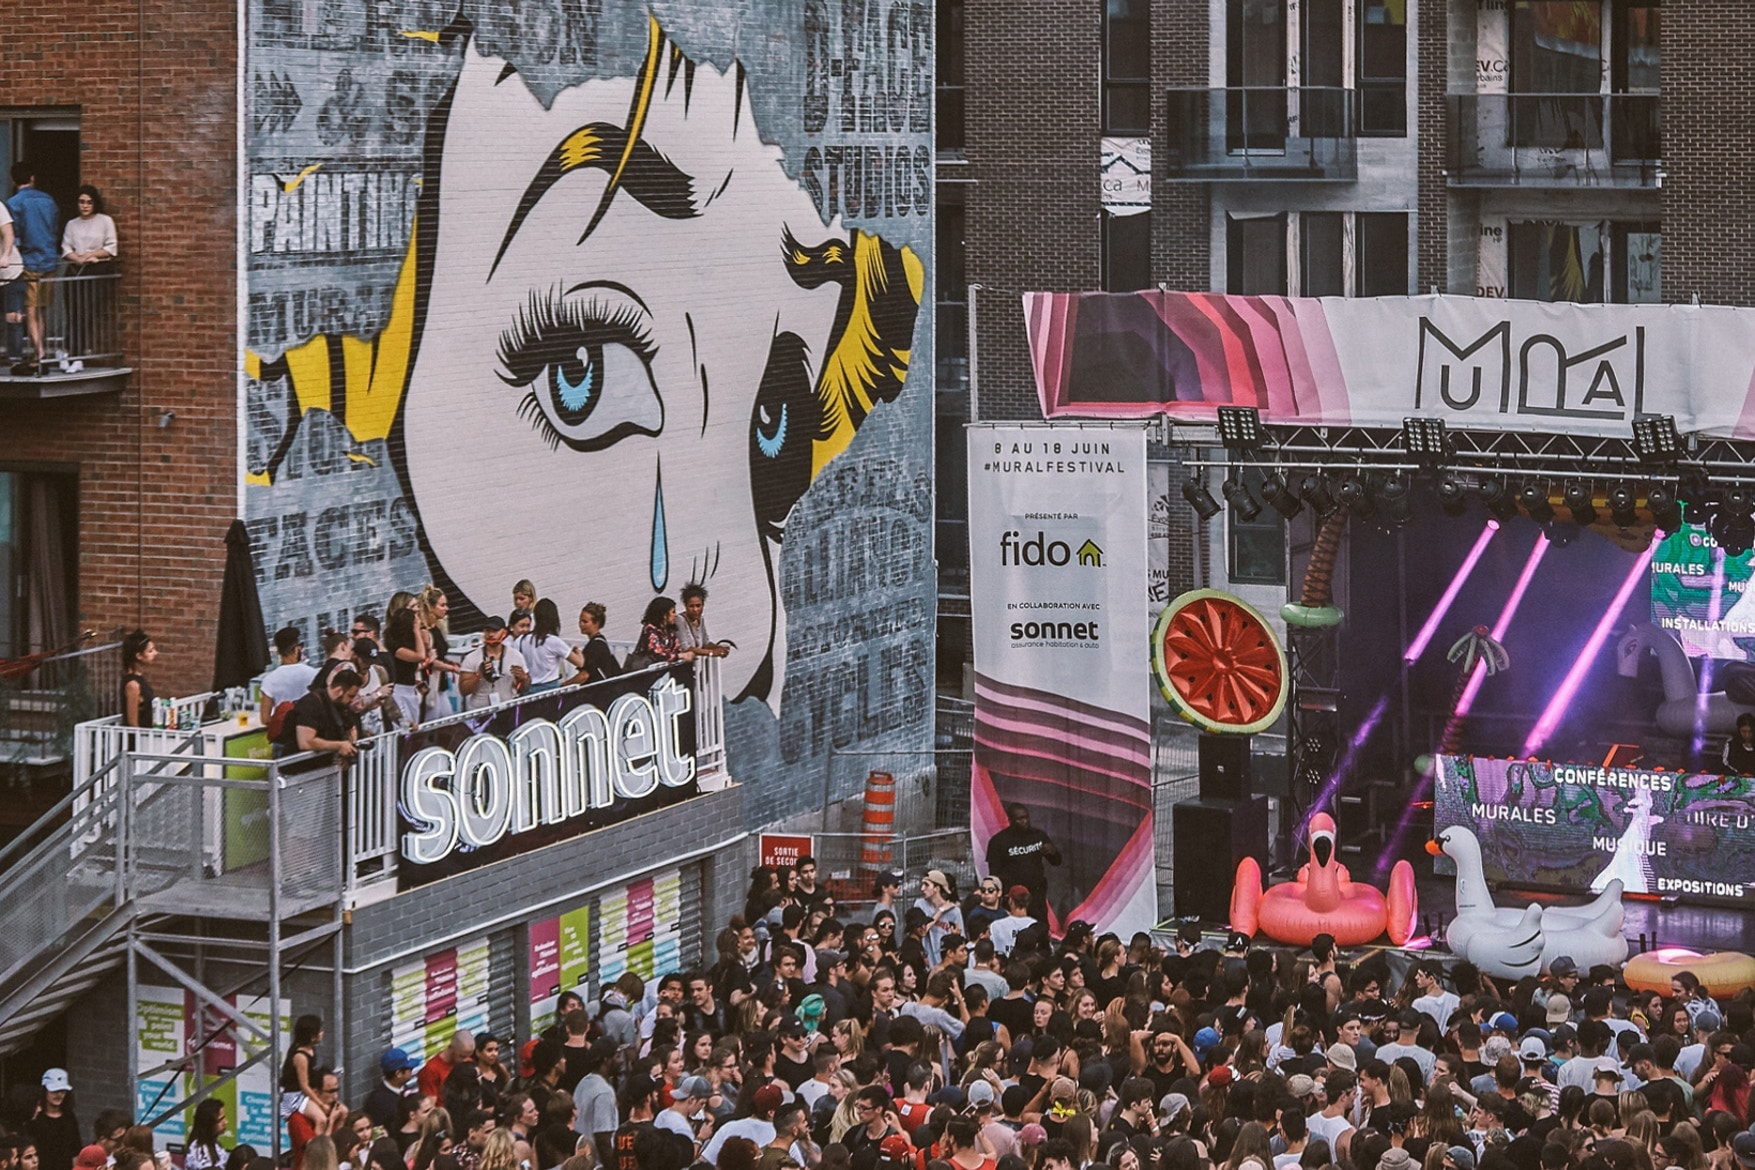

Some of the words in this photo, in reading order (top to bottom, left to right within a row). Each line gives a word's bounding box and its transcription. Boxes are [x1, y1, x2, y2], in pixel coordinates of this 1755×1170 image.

[803, 145, 930, 219] STUDIOS
[1415, 316, 1662, 420] MURAL
[995, 443, 1001, 454] 8
[1012, 443, 1032, 454] AU
[1043, 443, 1061, 454] 18
[1071, 443, 1110, 454] JUIN
[984, 461, 1124, 473] #MURALFESTIVAL
[1025, 512, 1061, 520] PRÉSENTÉ
[1000, 531, 1070, 566] fido
[1010, 621, 1099, 640] sonnet
[402, 674, 696, 865] sonnet
[1554, 767, 1671, 791] CONFÉRENCES
[1471, 803, 1556, 825] MURALES
[774, 847, 798, 857] SORTIE
[1657, 878, 1744, 897] EXPOSITIONS
